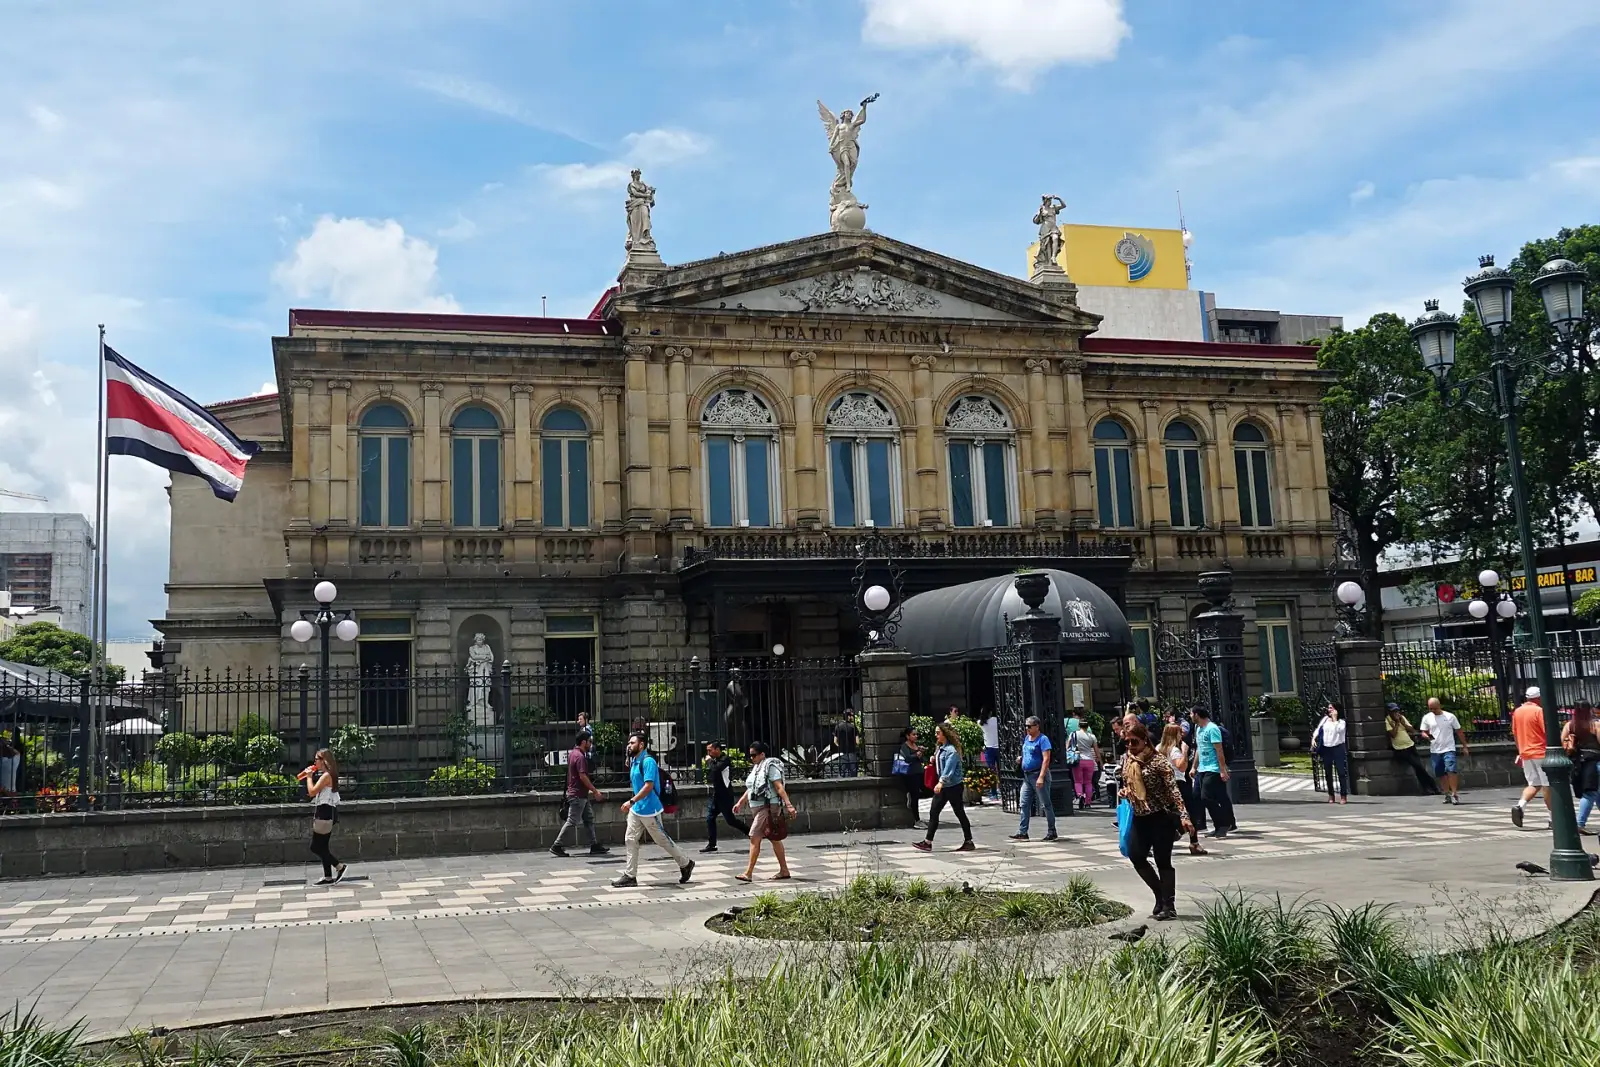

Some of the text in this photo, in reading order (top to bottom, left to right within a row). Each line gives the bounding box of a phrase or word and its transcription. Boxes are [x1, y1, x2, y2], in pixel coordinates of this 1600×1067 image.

[770, 325, 954, 345] TEATRO NACIONAL
[1575, 568, 1594, 583] BAR
